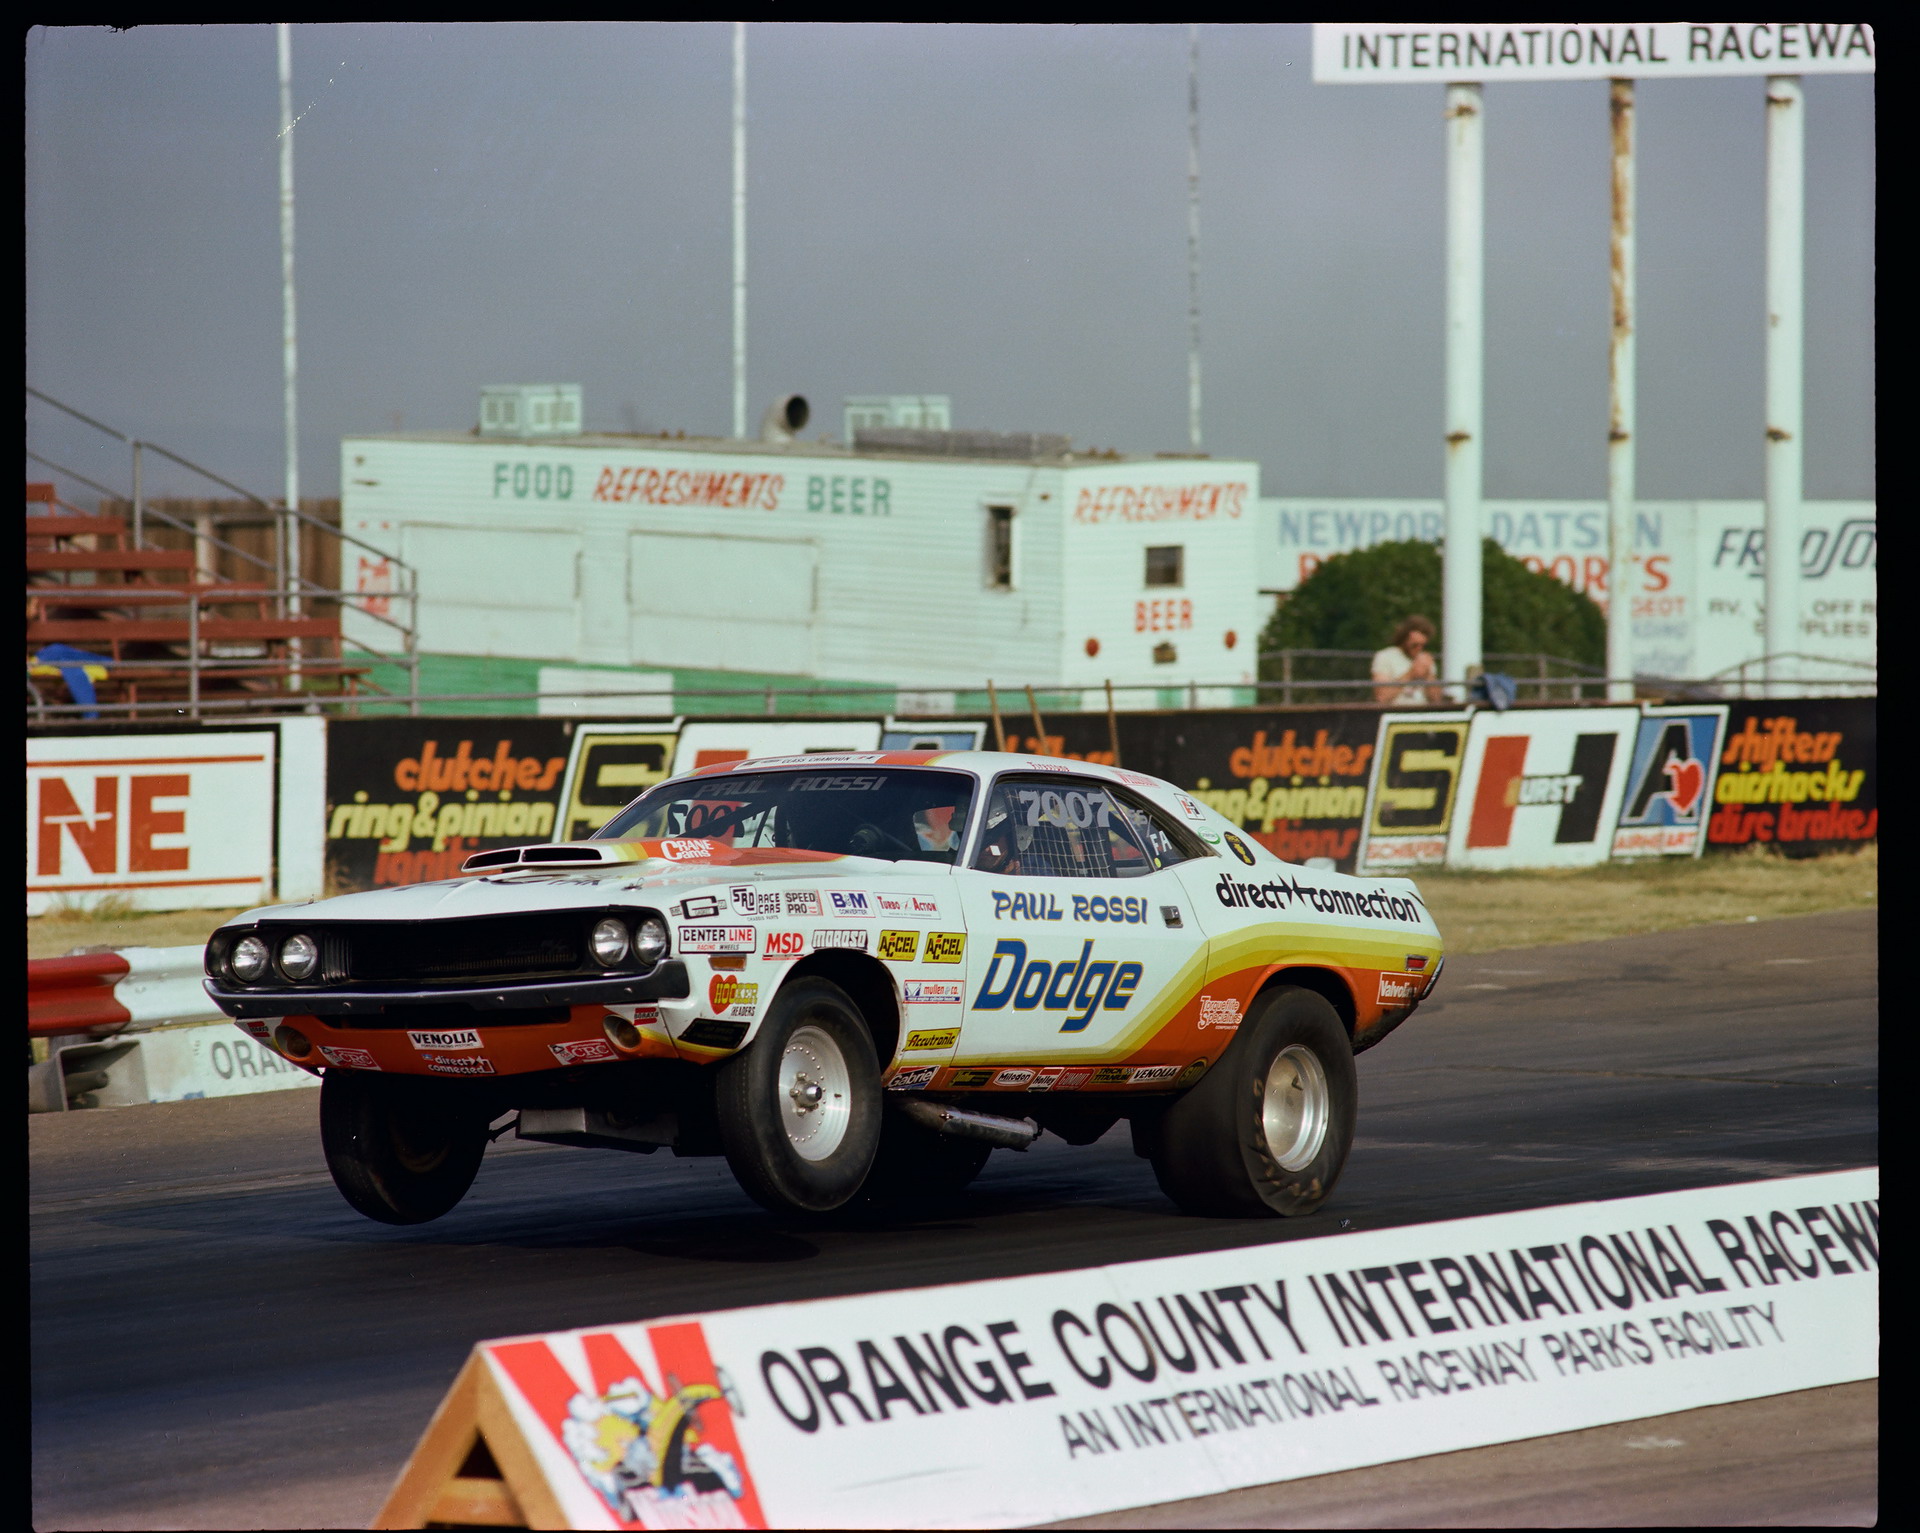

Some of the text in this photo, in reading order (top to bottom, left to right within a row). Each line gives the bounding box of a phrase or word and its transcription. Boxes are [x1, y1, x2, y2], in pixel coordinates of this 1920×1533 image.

[1342, 23, 1875, 69] INTERNATIONAL RACEWA
[493, 463, 891, 515] FOOD REFRESHMENTS BEER
[1074, 482, 1248, 524] REFRESHMENTS
[1279, 510, 1661, 549] NEWPOR DATSN
[1135, 599, 1193, 633] BEER
[1229, 728, 1374, 778] clutches
[1722, 716, 1843, 771] shifters
[394, 740, 566, 792] clutches
[788, 775, 888, 792] ROSSI
[1018, 790, 1111, 829] 7007
[1186, 776, 1366, 834] ing&pinion
[1777, 801, 1878, 843] brakes
[758, 892, 780, 903] RACE
[758, 903, 781, 915] CARS
[785, 892, 816, 903] SPEED
[787, 903, 808, 914] PRO
[991, 890, 1148, 925] PAUL ROSSI
[1215, 873, 1421, 924] direct connection
[683, 928, 753, 942] CENTER LINE
[765, 932, 804, 955] MSD
[714, 982, 758, 1005] HOOKER
[971, 938, 1145, 1034] Dodge
[731, 1006, 756, 1017] HEADERS
[411, 1032, 478, 1046] VENOLIA
[572, 1045, 610, 1058] CRC
[340, 1052, 372, 1066] CRC
[428, 1063, 485, 1074] connected
[434, 1055, 468, 1067] direct
[888, 1069, 933, 1088] Gabriel
[1133, 1067, 1178, 1080] VENOLIA
[759, 1320, 1057, 1435] ORANGE
[1052, 1278, 1308, 1391] COUNTY
[1307, 1225, 1729, 1348] INTERNATIONAL
[1059, 1301, 1785, 1459] AN INTERNATIONAL RACEWAY PARKS FACILITY
